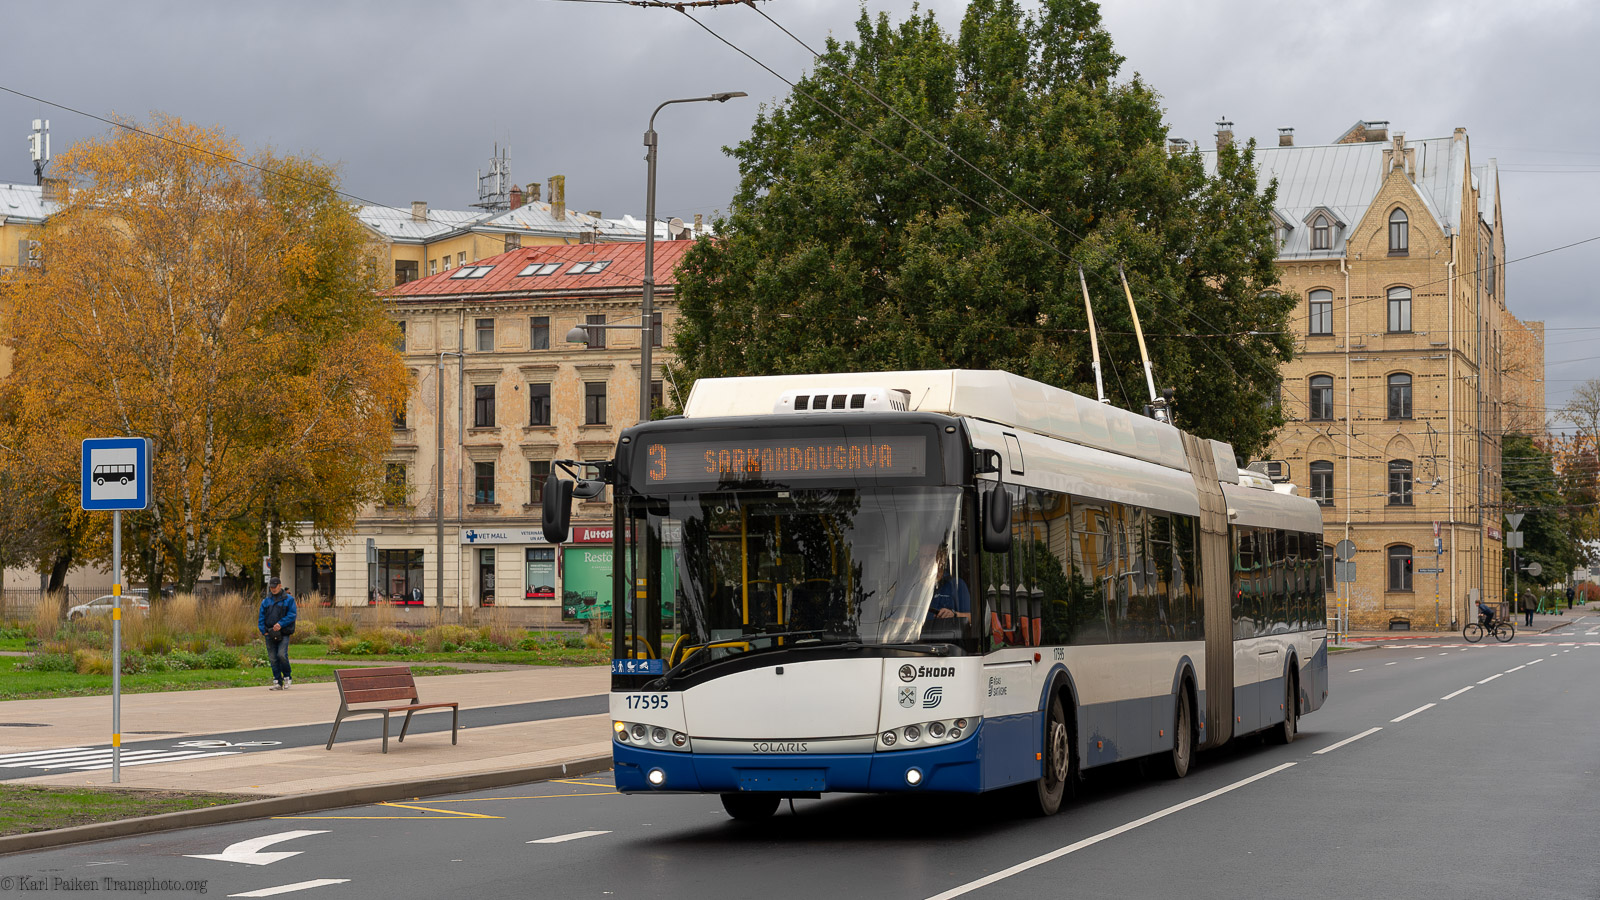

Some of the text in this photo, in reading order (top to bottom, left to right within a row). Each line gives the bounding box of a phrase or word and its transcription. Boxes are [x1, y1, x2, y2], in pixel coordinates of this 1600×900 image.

[649, 443, 892, 481] 3 SARKANDAUGAVA
[584, 552, 613, 563] Resto
[918, 666, 956, 678] ŠKODA
[626, 695, 669, 710] 17595
[752, 742, 808, 753] SOLARIS
